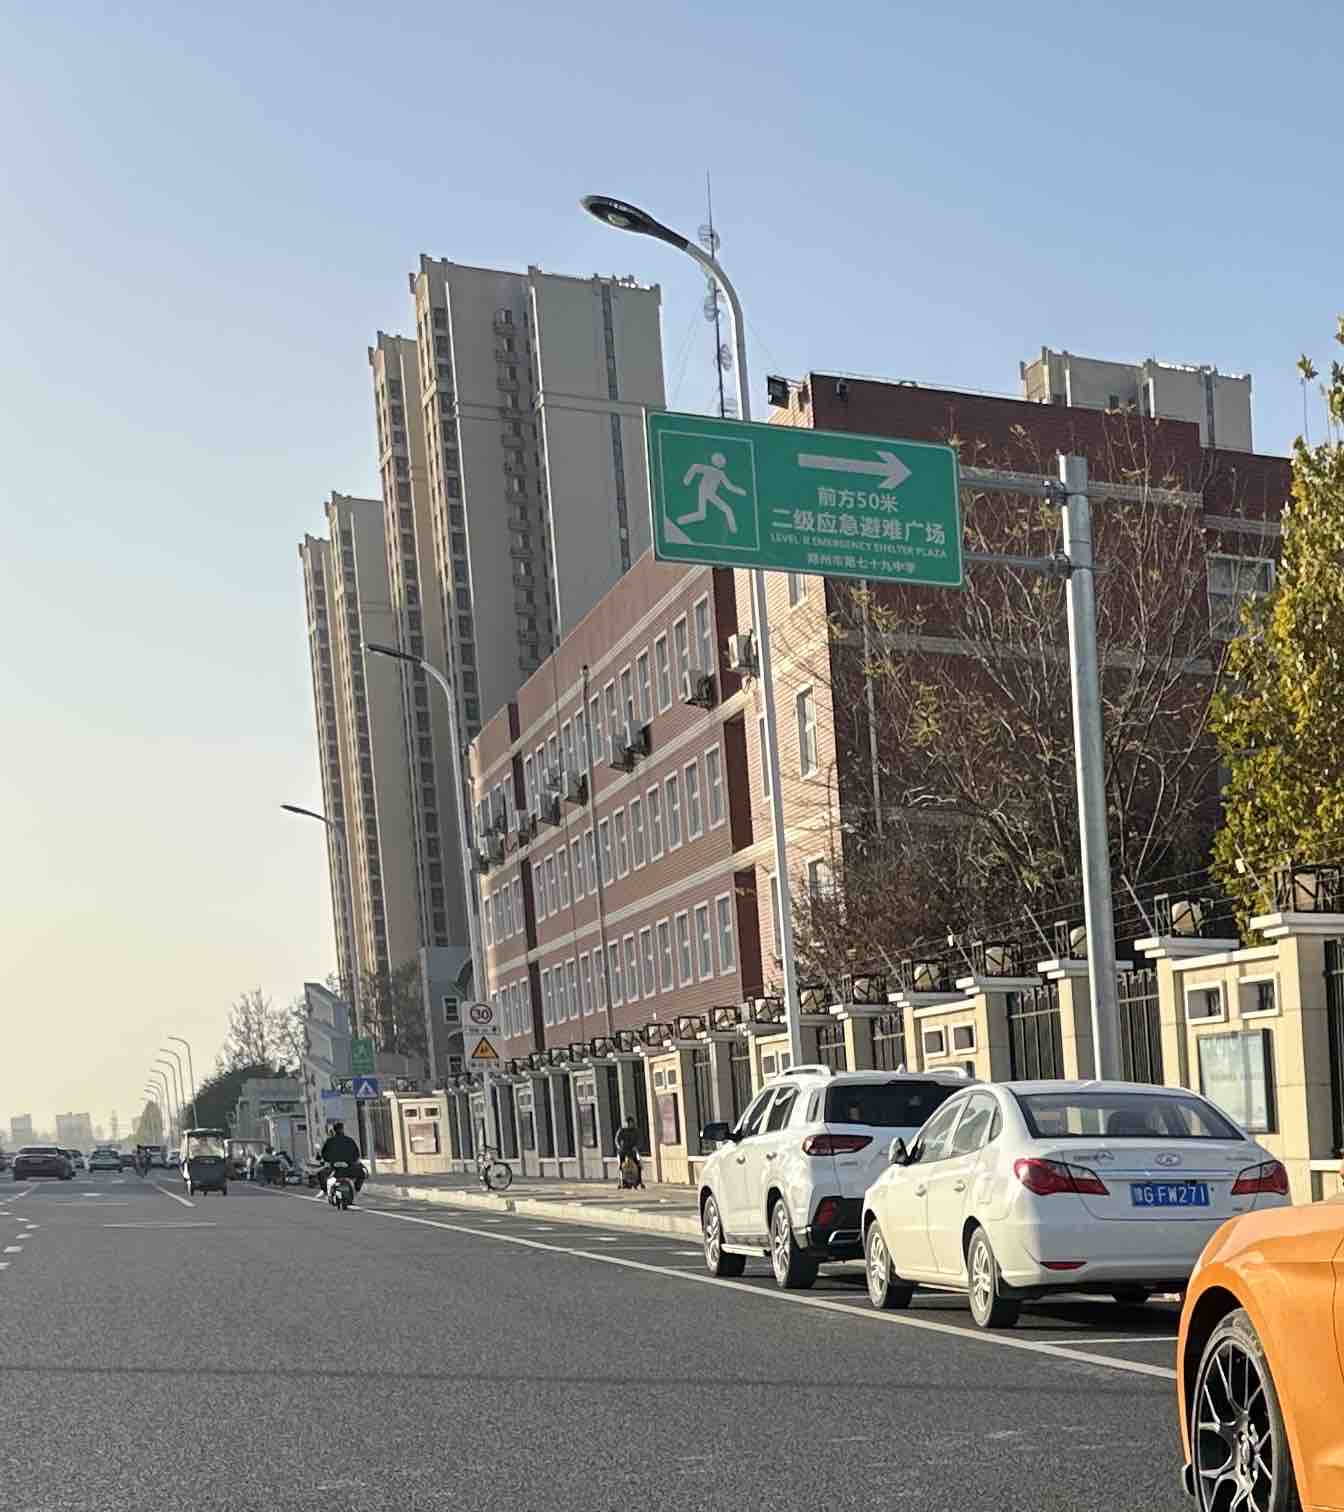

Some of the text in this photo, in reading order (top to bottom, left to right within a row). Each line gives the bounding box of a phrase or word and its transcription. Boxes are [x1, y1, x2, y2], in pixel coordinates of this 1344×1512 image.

[817, 487, 898, 512] 前方50米
[771, 508, 946, 545] 二级应急避难广场
